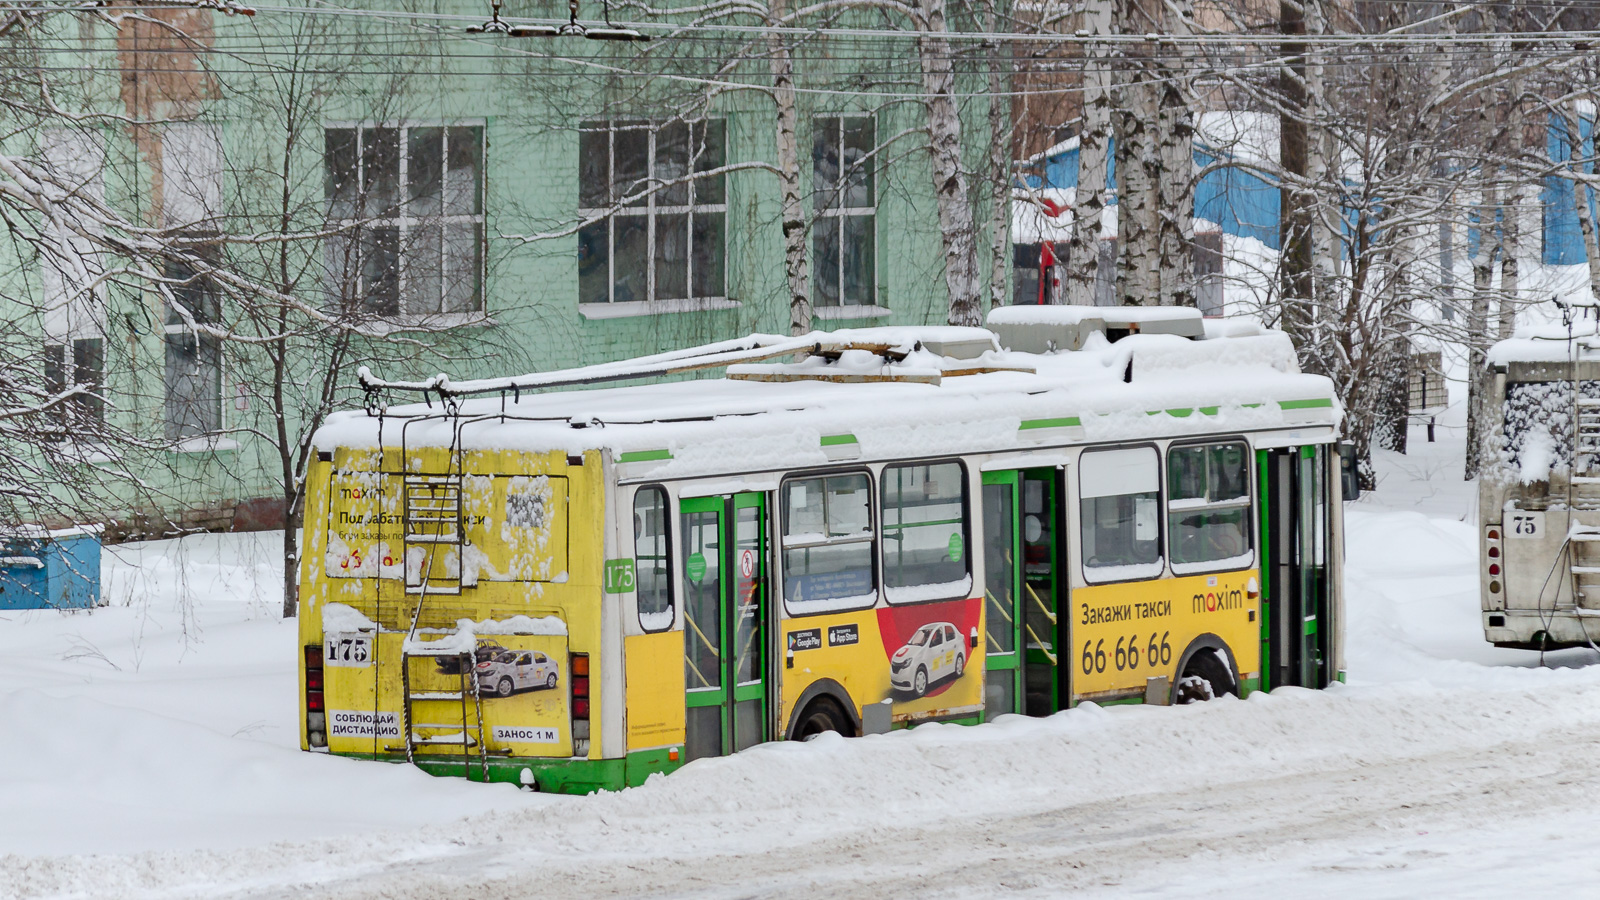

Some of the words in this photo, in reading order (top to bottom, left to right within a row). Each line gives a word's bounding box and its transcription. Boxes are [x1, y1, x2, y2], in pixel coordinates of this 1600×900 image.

[1513, 515, 1536, 535] 75
[607, 564, 634, 588] 175
[1193, 584, 1243, 614] maxim
[1081, 602, 1132, 625] Закажи
[1135, 600, 1172, 619] такси
[328, 638, 367, 662] 175
[335, 712, 394, 724] СОБЛЮДАЙ
[332, 724, 399, 736] ДИСТАНЦИЮ
[497, 729, 533, 739] ЗАНОС
[536, 730, 542, 739] 1
